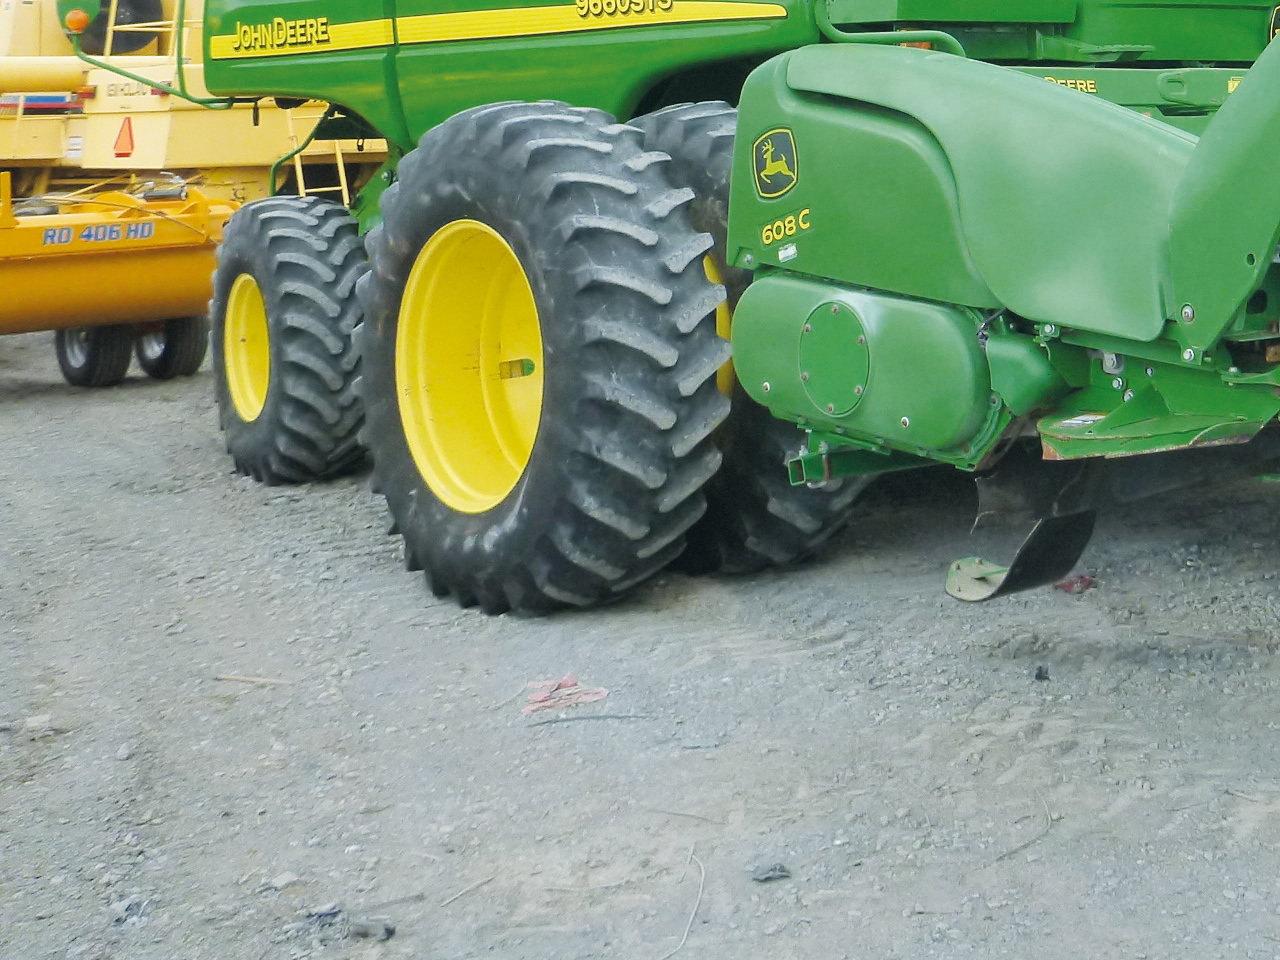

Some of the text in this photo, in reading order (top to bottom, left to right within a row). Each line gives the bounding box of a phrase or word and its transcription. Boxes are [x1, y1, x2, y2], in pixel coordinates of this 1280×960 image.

[79, 224, 122, 243] 406
[125, 221, 155, 239] HD
[762, 208, 810, 245] 608 C
